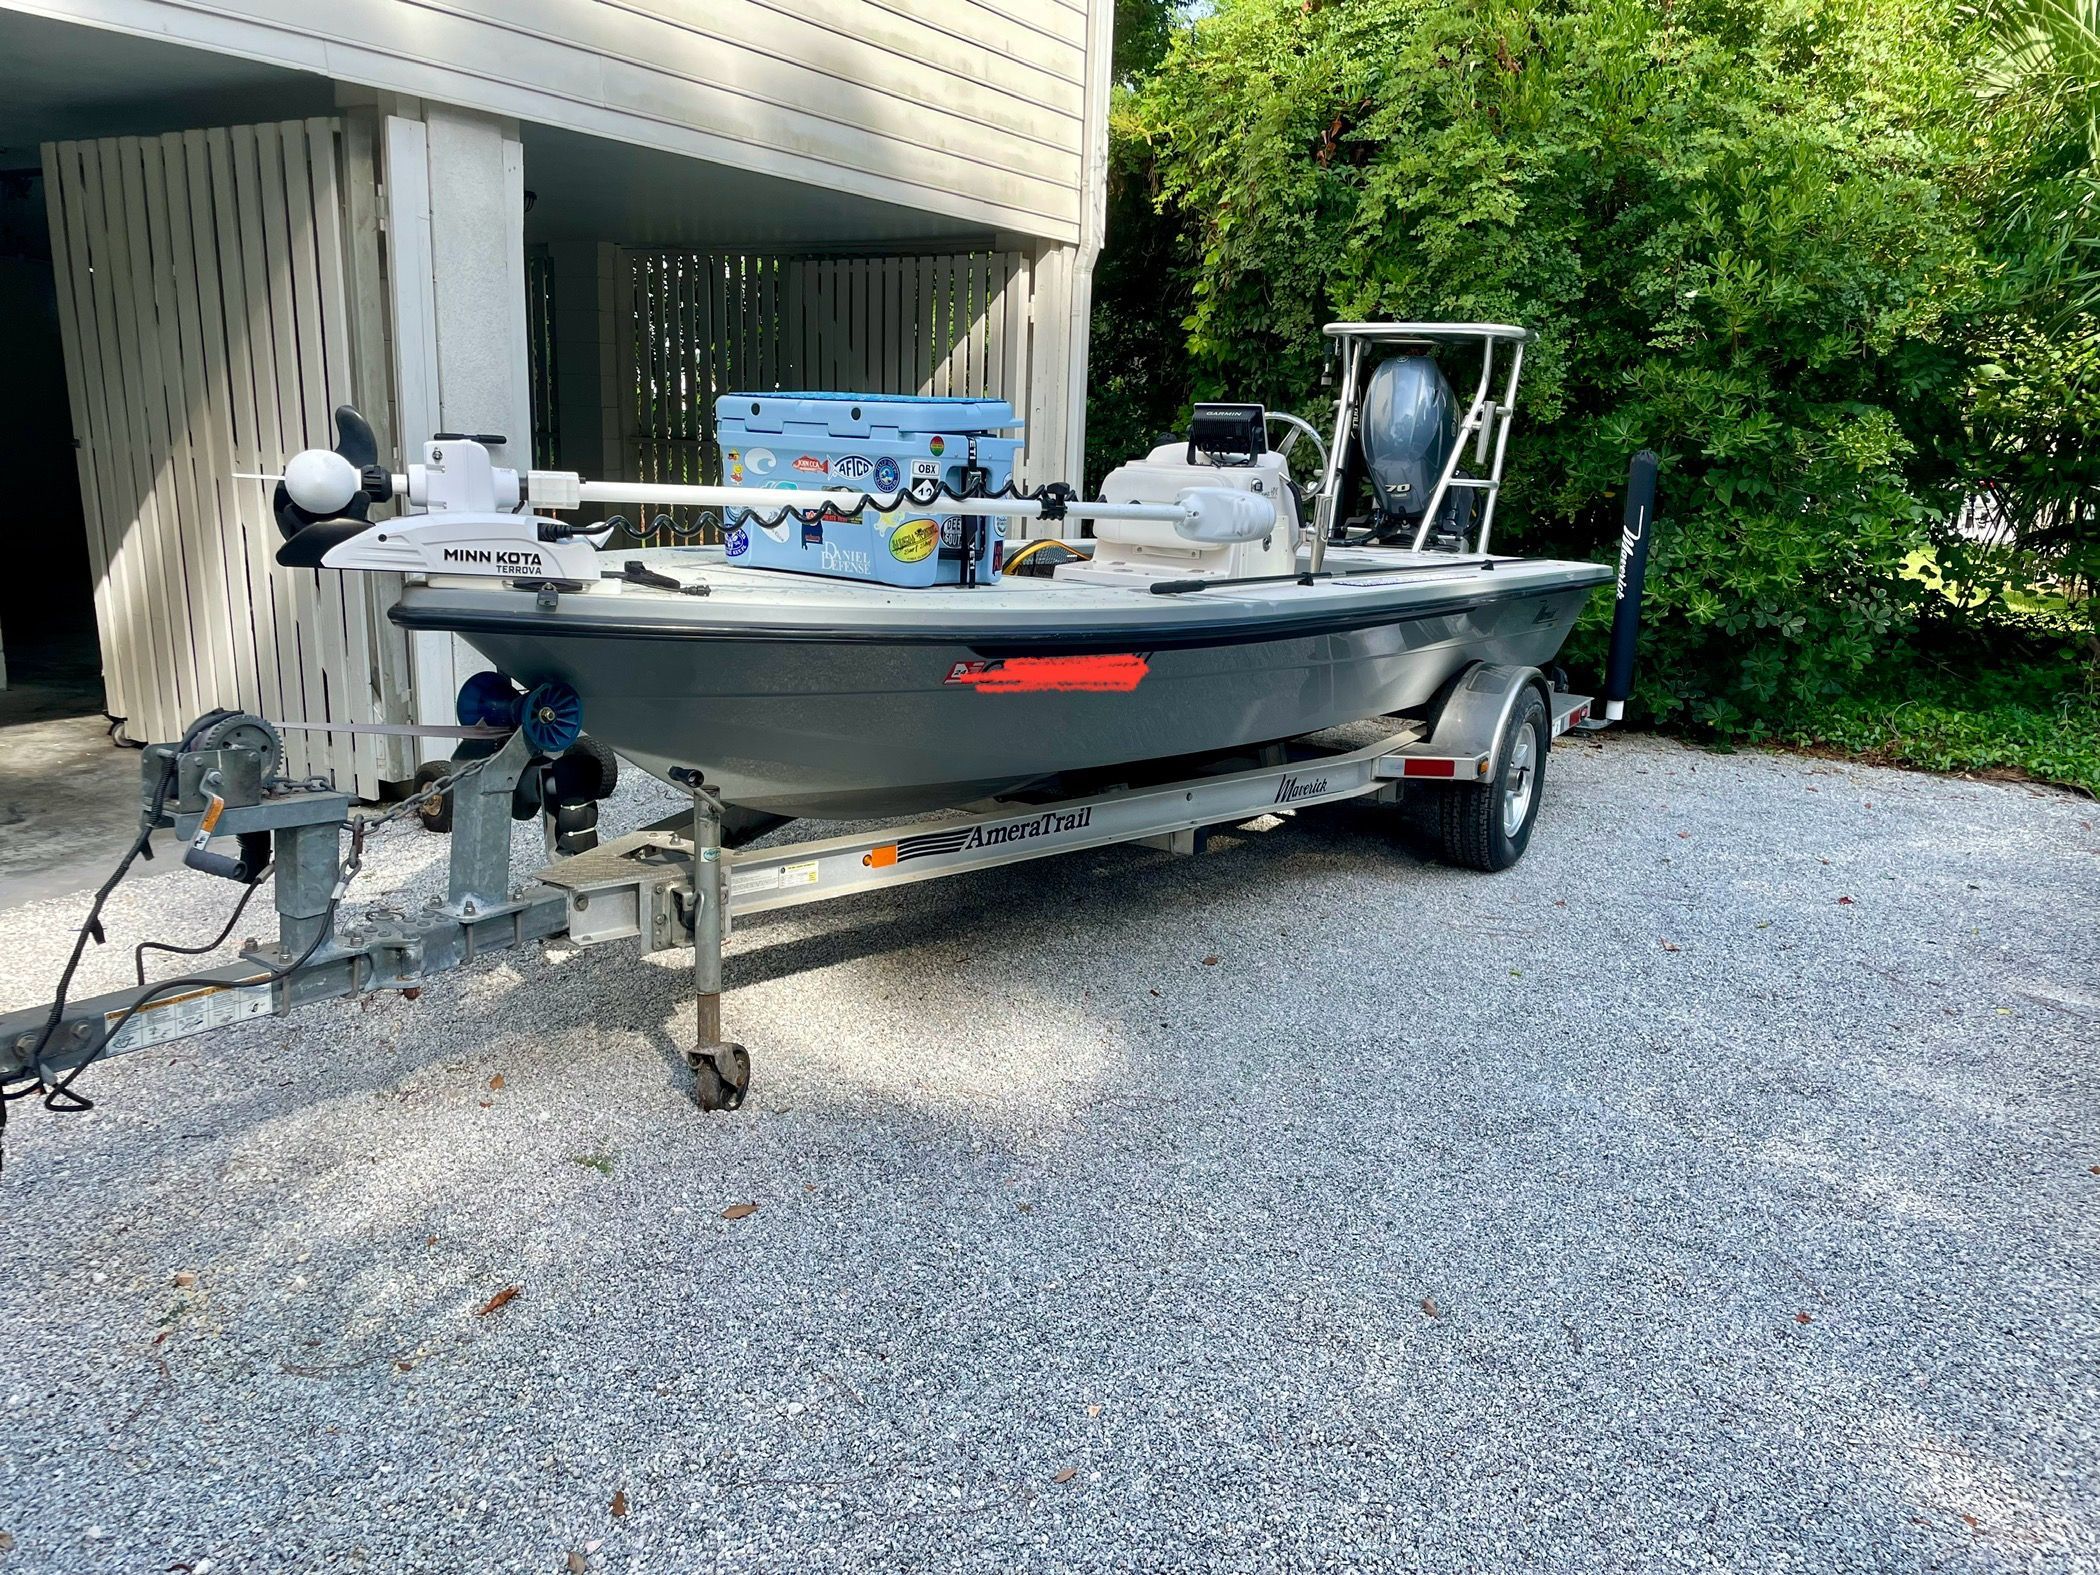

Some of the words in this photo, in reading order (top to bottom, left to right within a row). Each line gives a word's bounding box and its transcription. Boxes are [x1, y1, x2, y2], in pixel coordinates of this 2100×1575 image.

[968, 437, 977, 460] ETI
[839, 457, 869, 477] AFTCO
[918, 464, 936, 474] OBX
[1385, 483, 1411, 493] 70
[946, 518, 962, 530] DEE
[944, 533, 962, 546] SOUT
[444, 549, 491, 562] MINN
[496, 551, 542, 565] KOTA
[821, 551, 871, 574] DEFENSE
[825, 541, 871, 564] DANIEL
[1616, 505, 1644, 600] Maverick
[496, 565, 542, 575] TERROVA
[1274, 774, 1328, 803] Maverick
[965, 807, 1092, 850] AmeraTrail
